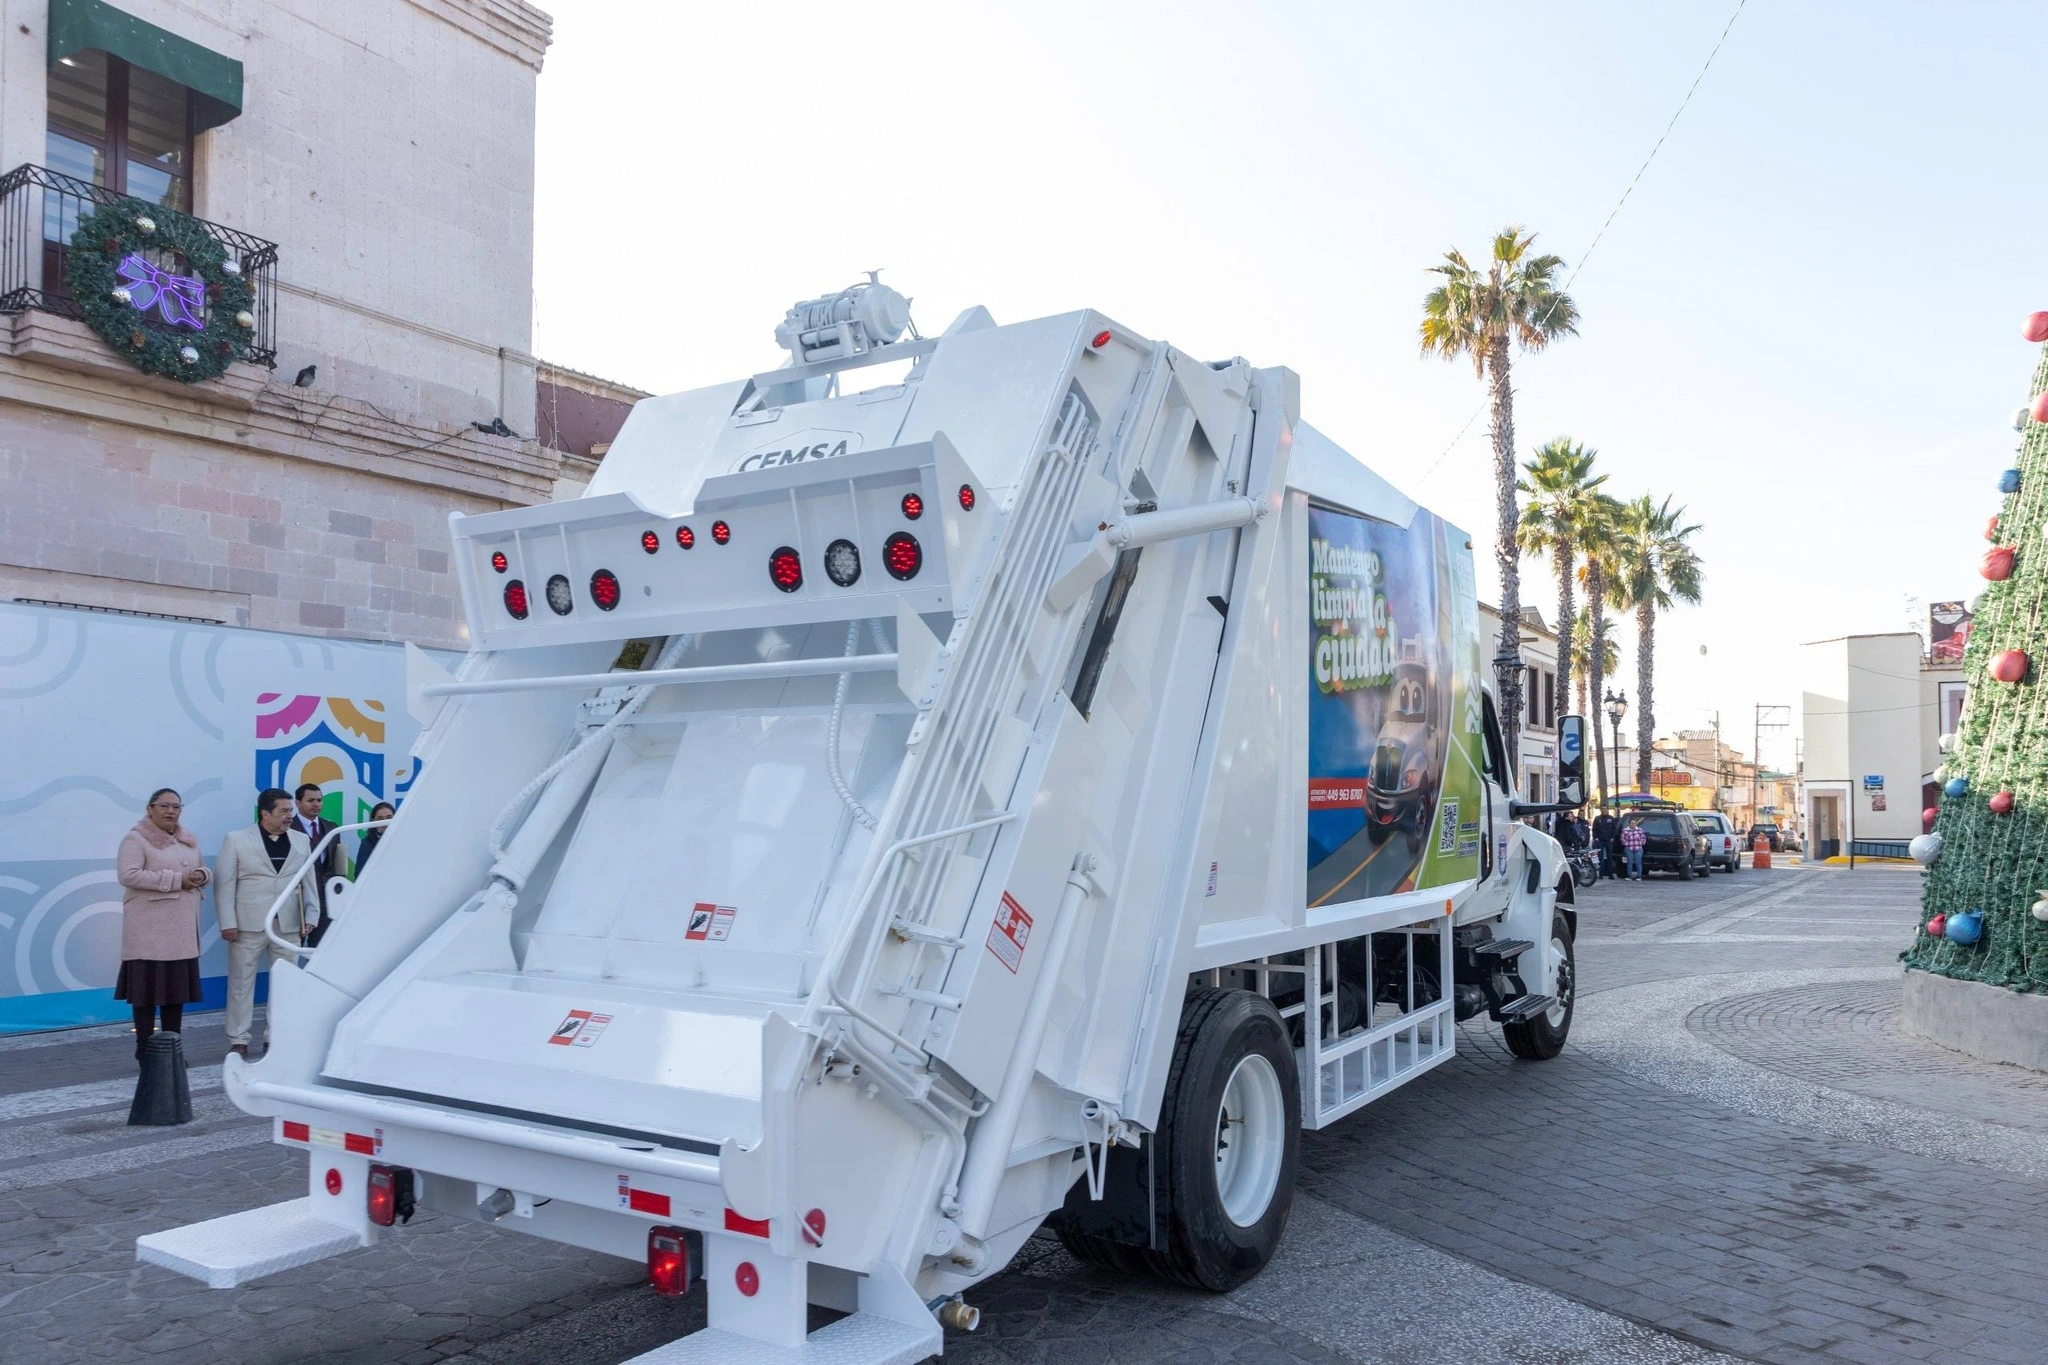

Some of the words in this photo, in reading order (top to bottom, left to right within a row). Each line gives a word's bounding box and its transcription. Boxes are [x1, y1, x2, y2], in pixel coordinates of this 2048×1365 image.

[1312, 540, 1379, 585] Mantengo
[1312, 578, 1367, 629] limpia
[1366, 586, 1386, 629] la
[1316, 618, 1397, 683] ciudad
[1327, 789, 1339, 800] 449
